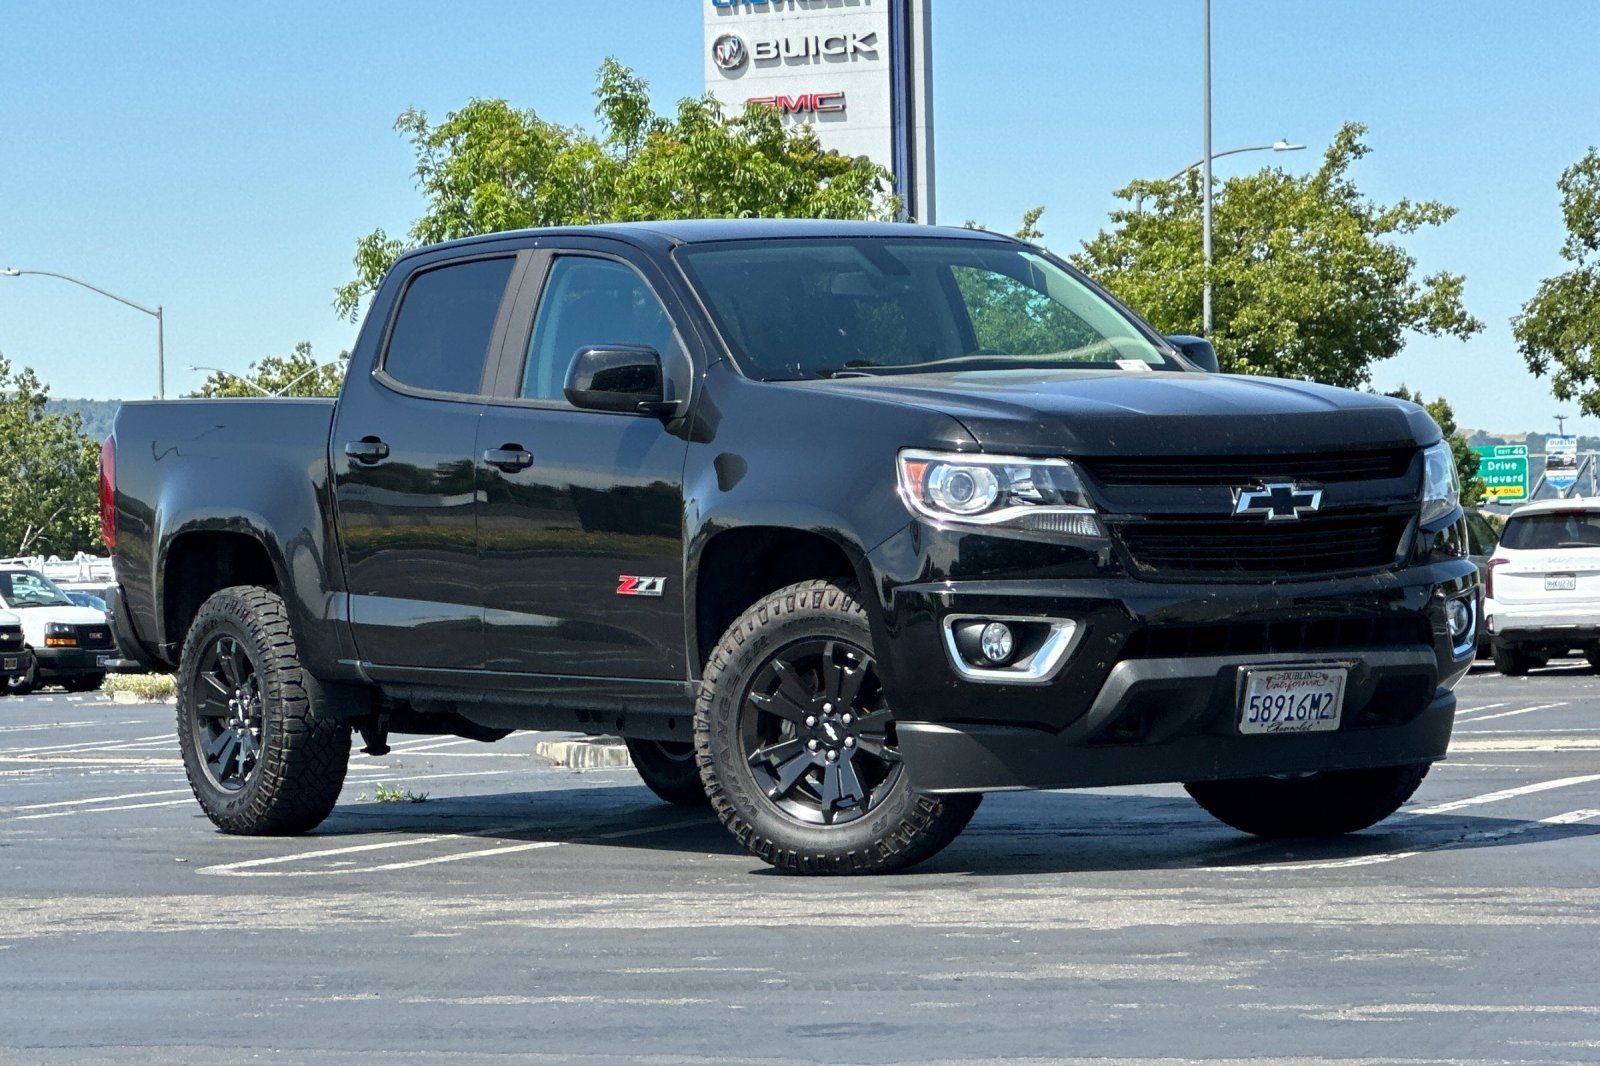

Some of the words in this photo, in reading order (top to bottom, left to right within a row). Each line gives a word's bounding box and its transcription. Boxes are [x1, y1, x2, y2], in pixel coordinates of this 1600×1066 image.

[755, 32, 880, 60] BUICK
[1512, 447, 1524, 455] 46
[1487, 461, 1518, 471] Drive
[1484, 473, 1524, 484] levard
[616, 575, 667, 597] Z71
[1283, 671, 1312, 681] DUBLIN
[1266, 678, 1325, 692] California
[1248, 692, 1334, 723] 58916M2
